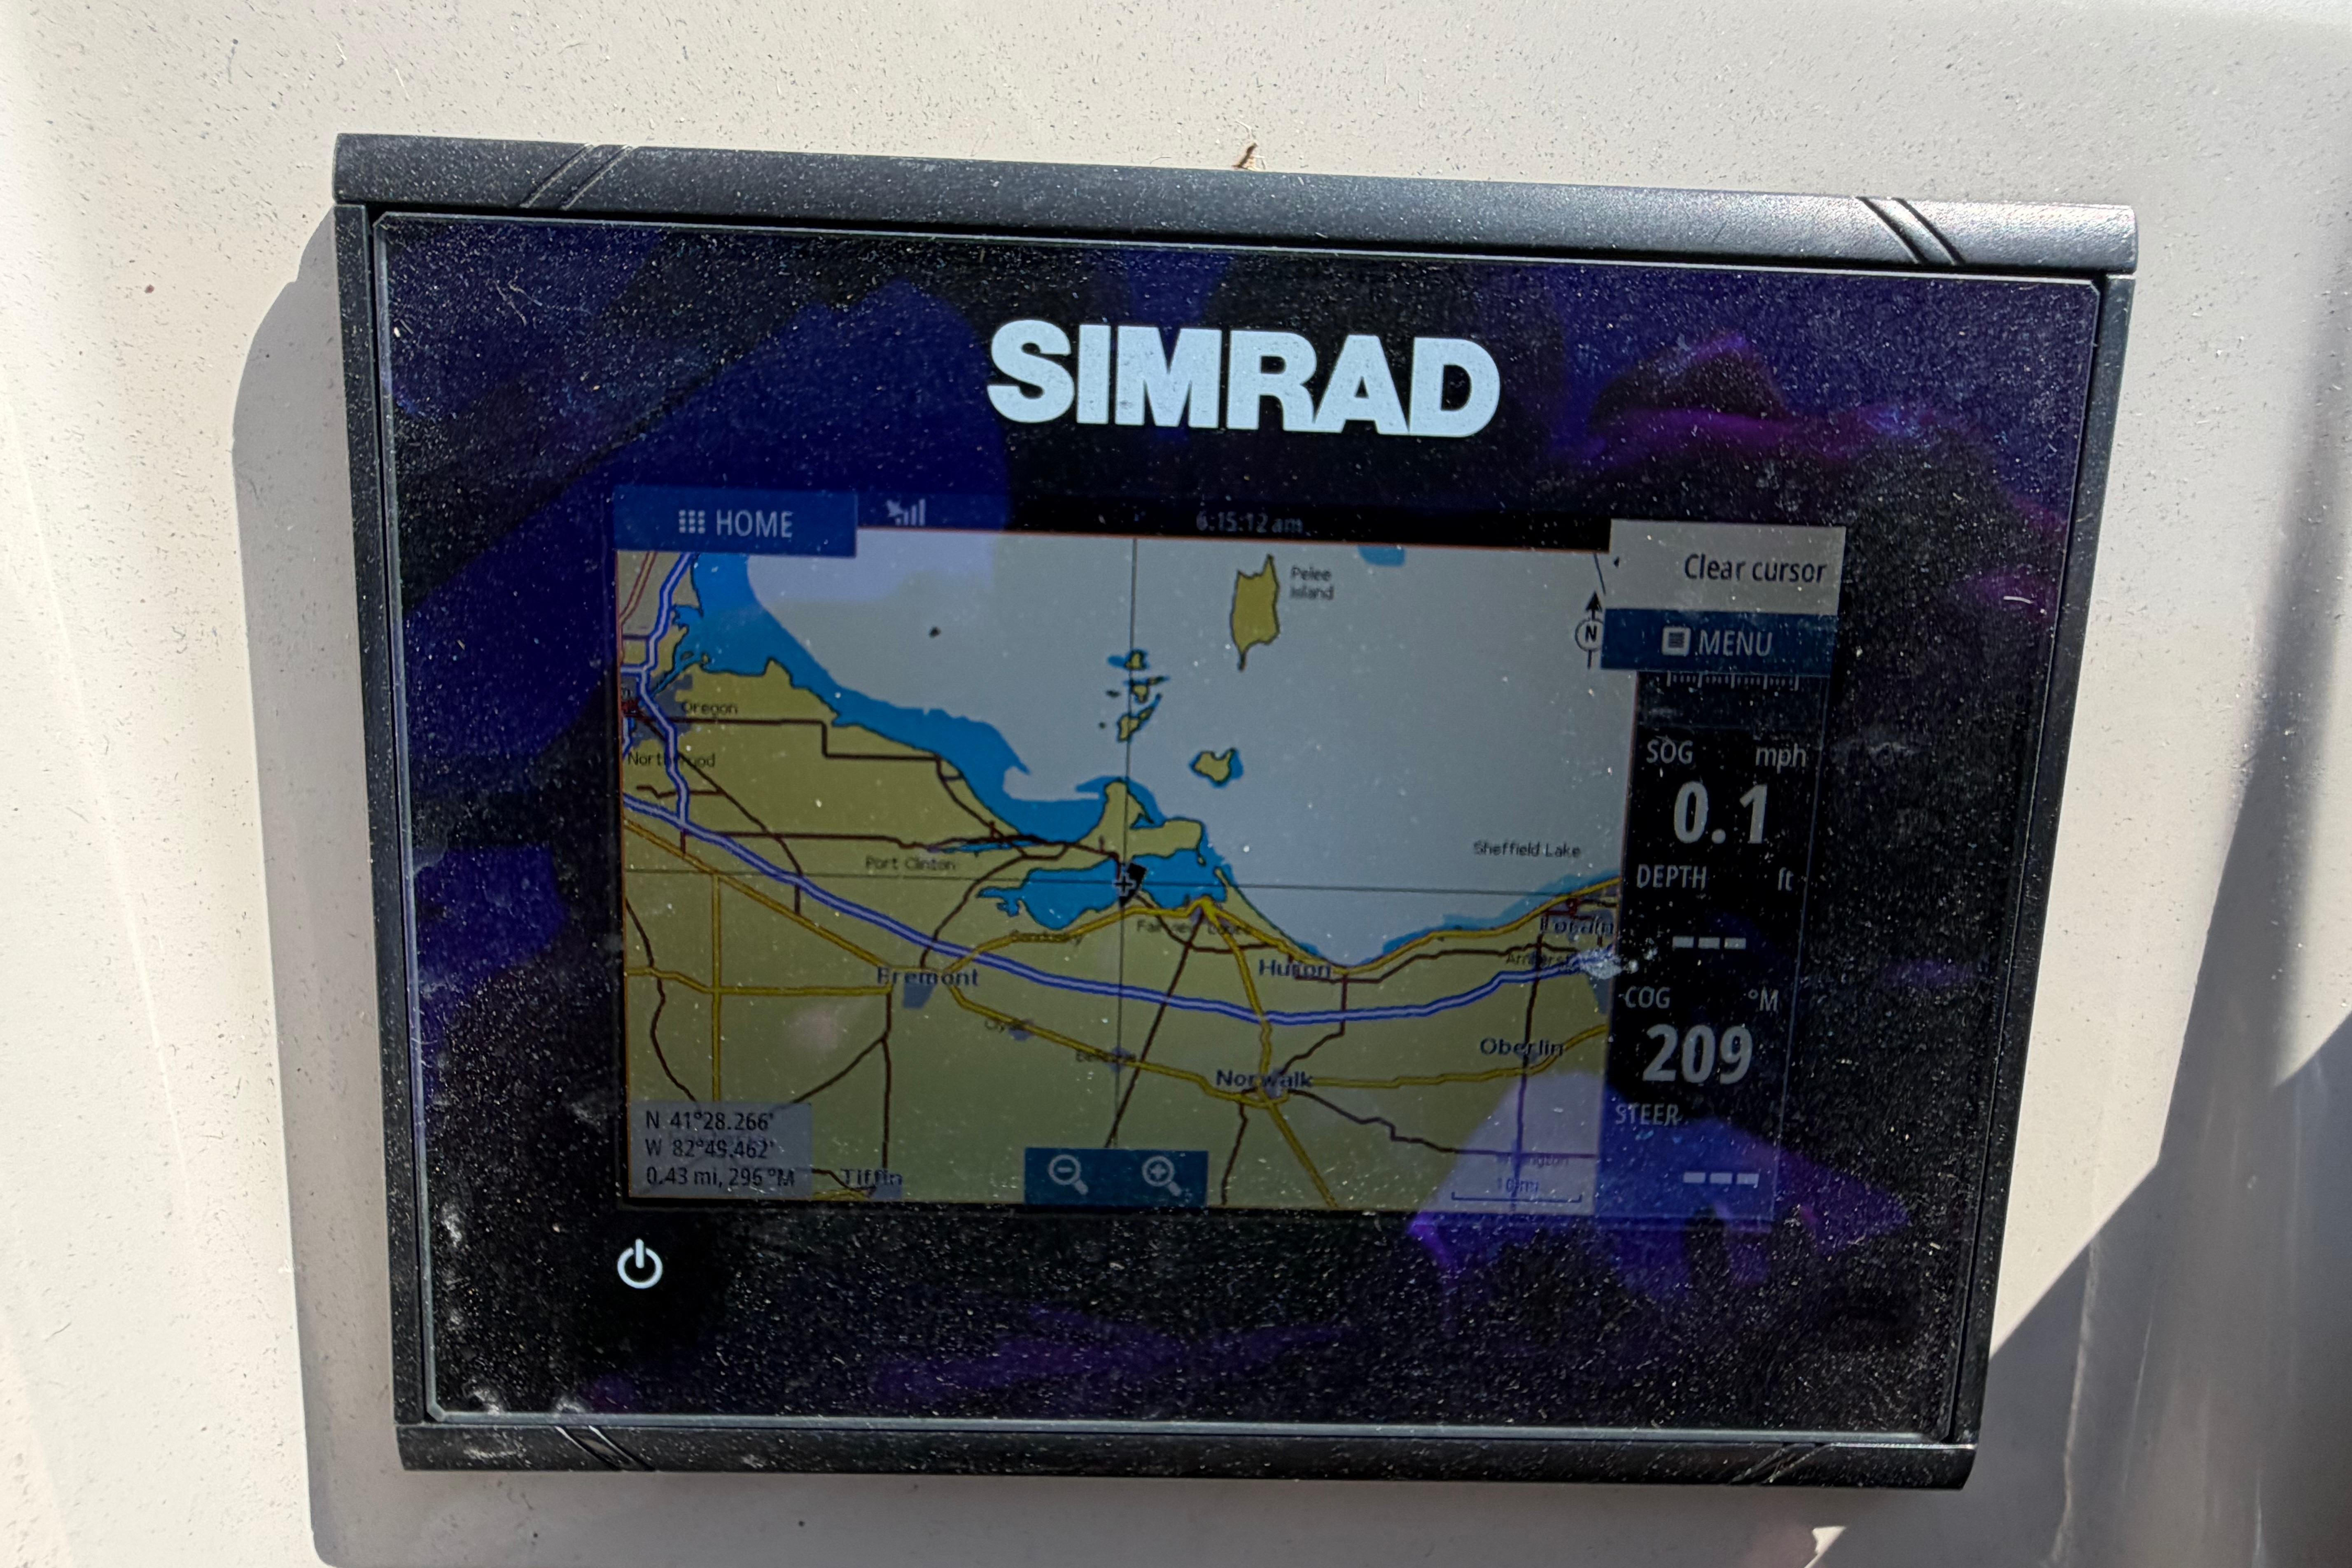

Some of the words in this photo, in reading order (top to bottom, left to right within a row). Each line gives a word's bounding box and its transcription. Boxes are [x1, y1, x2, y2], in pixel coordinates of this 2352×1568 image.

[987, 319, 1500, 438] SIMRAD
[716, 509, 794, 538] HOME
[1272, 518, 1304, 534] am
[1684, 553, 1746, 581] Clear
[1752, 561, 1827, 583] cursor
[1585, 624, 1598, 642] N
[1698, 630, 1773, 657] MENU
[681, 701, 738, 717] Oregon
[1647, 740, 1694, 765] SOG
[1755, 743, 1807, 773] mph
[1673, 781, 1768, 845] 0.1
[1473, 840, 1541, 857] Sheffield
[1545, 842, 1582, 858] Lake
[866, 856, 898, 870] Port
[905, 856, 956, 870] Clinton
[1636, 864, 1707, 890] DEPTH
[1778, 867, 1794, 891] ft
[877, 968, 978, 987] Fremont
[1625, 986, 1671, 1008] COG
[1479, 1037, 1564, 1057] Oberlin
[1642, 1023, 1753, 1085] 209
[1216, 1069, 1313, 1087] Norwalk
[646, 1111, 660, 1129] N
[1615, 1103, 1681, 1126] STEER
[645, 1138, 662, 1157] W
[646, 1166, 688, 1185] 0.43
[694, 1167, 723, 1188] mi,
